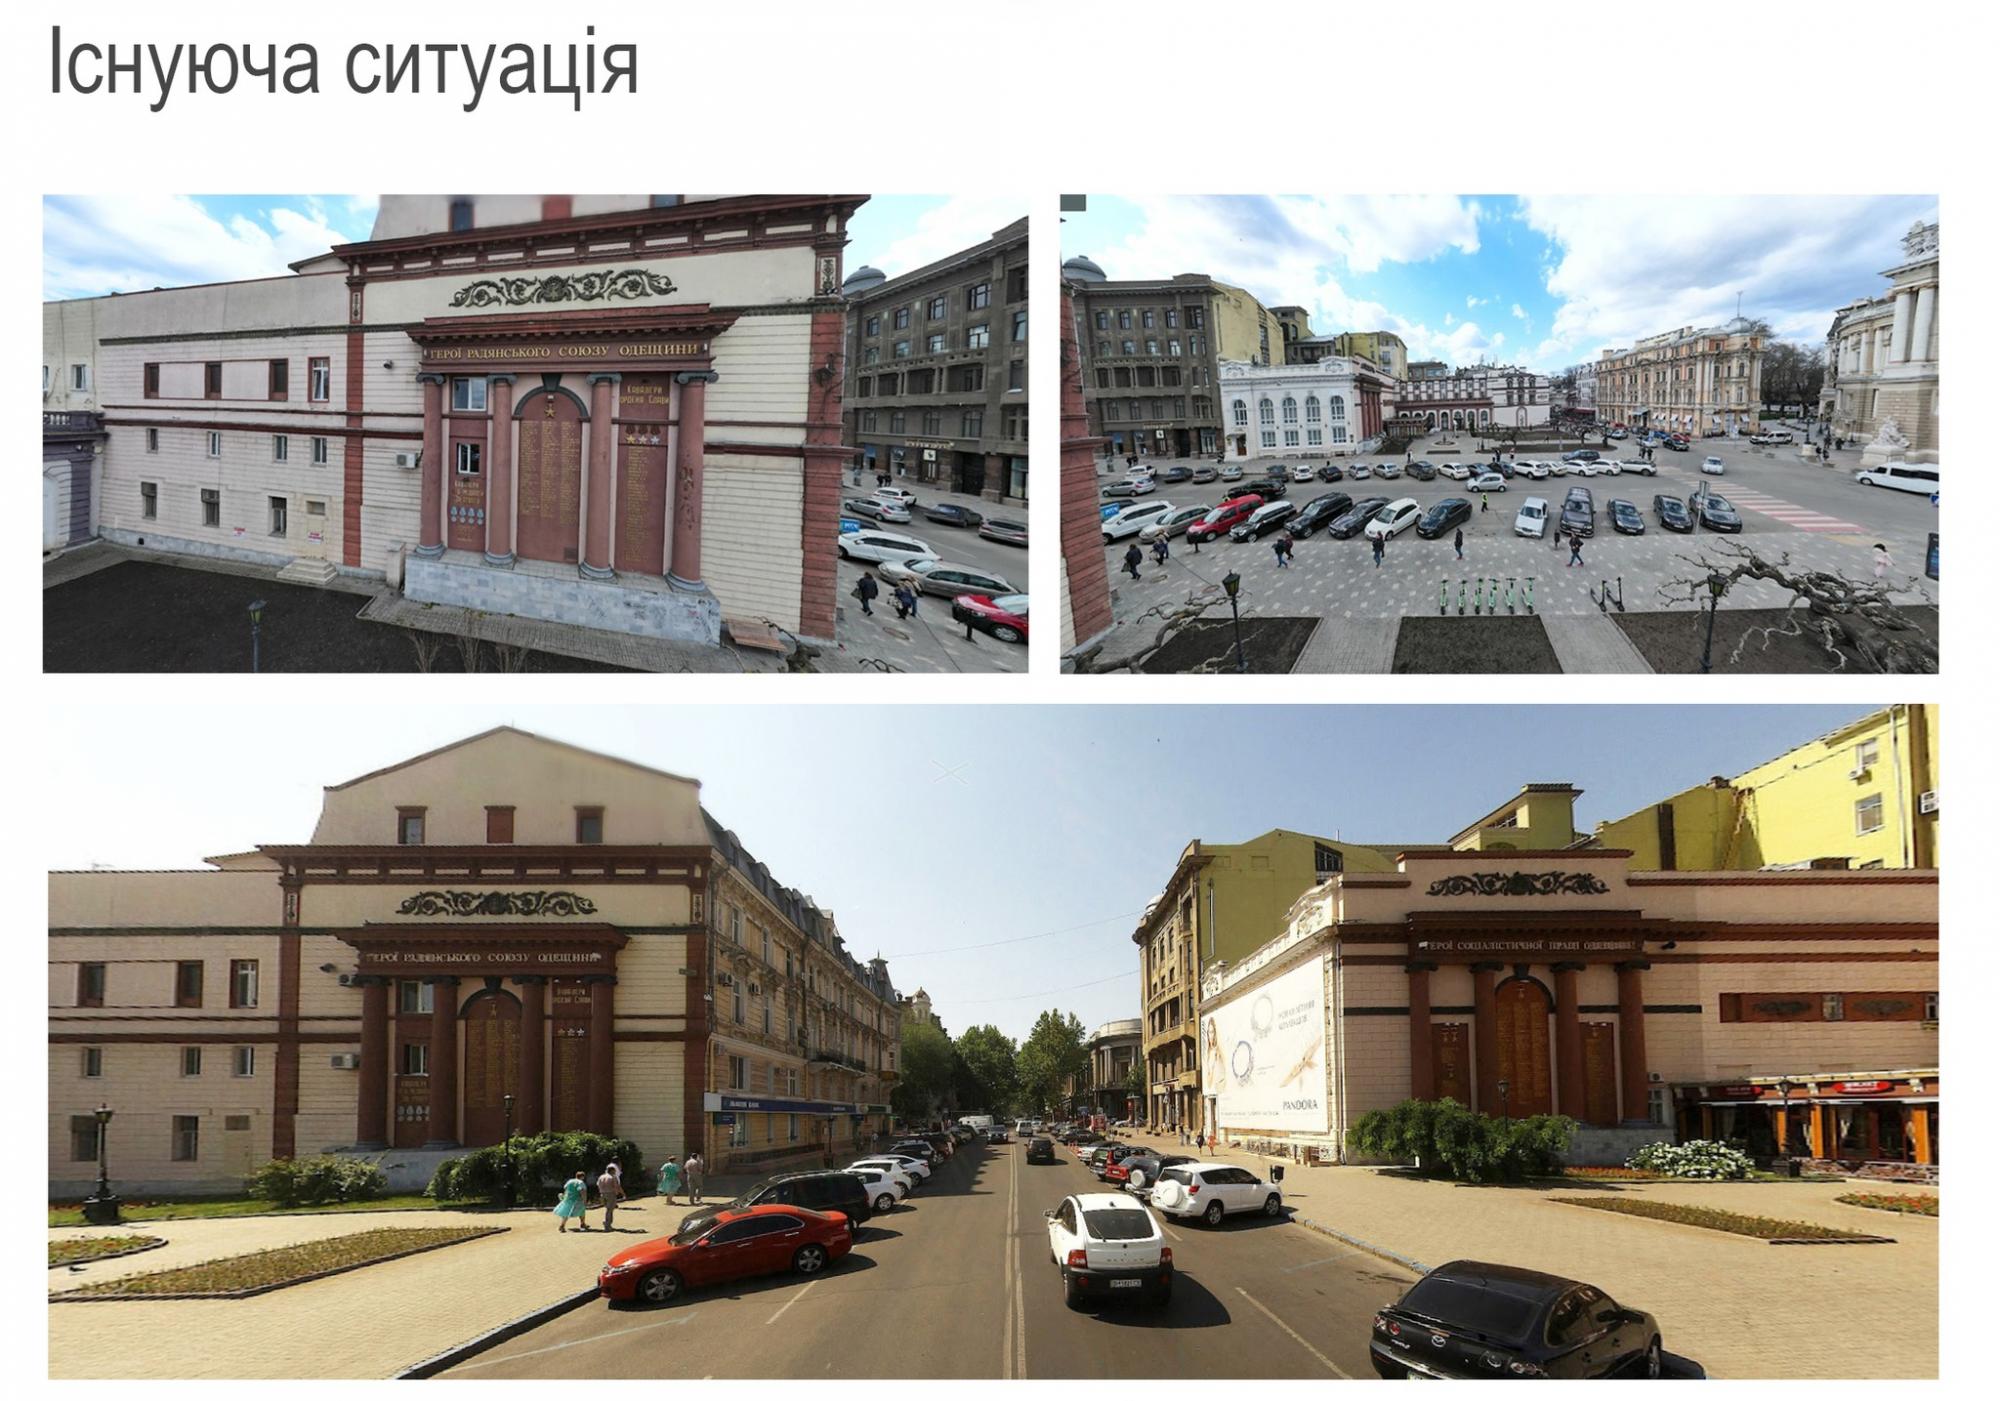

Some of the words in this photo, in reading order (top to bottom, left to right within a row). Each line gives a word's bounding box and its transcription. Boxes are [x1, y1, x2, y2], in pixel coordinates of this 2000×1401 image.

[429, 347, 463, 360] ГЕРОЇ
[467, 347, 550, 360] РАДЯНСЬКОГО
[558, 345, 609, 357] СОЮЗУ
[619, 343, 698, 356] ОДЕЩИНИ
[488, 952, 531, 963] СОЮЗУ
[1283, 1099, 1319, 1111] PANDORA
